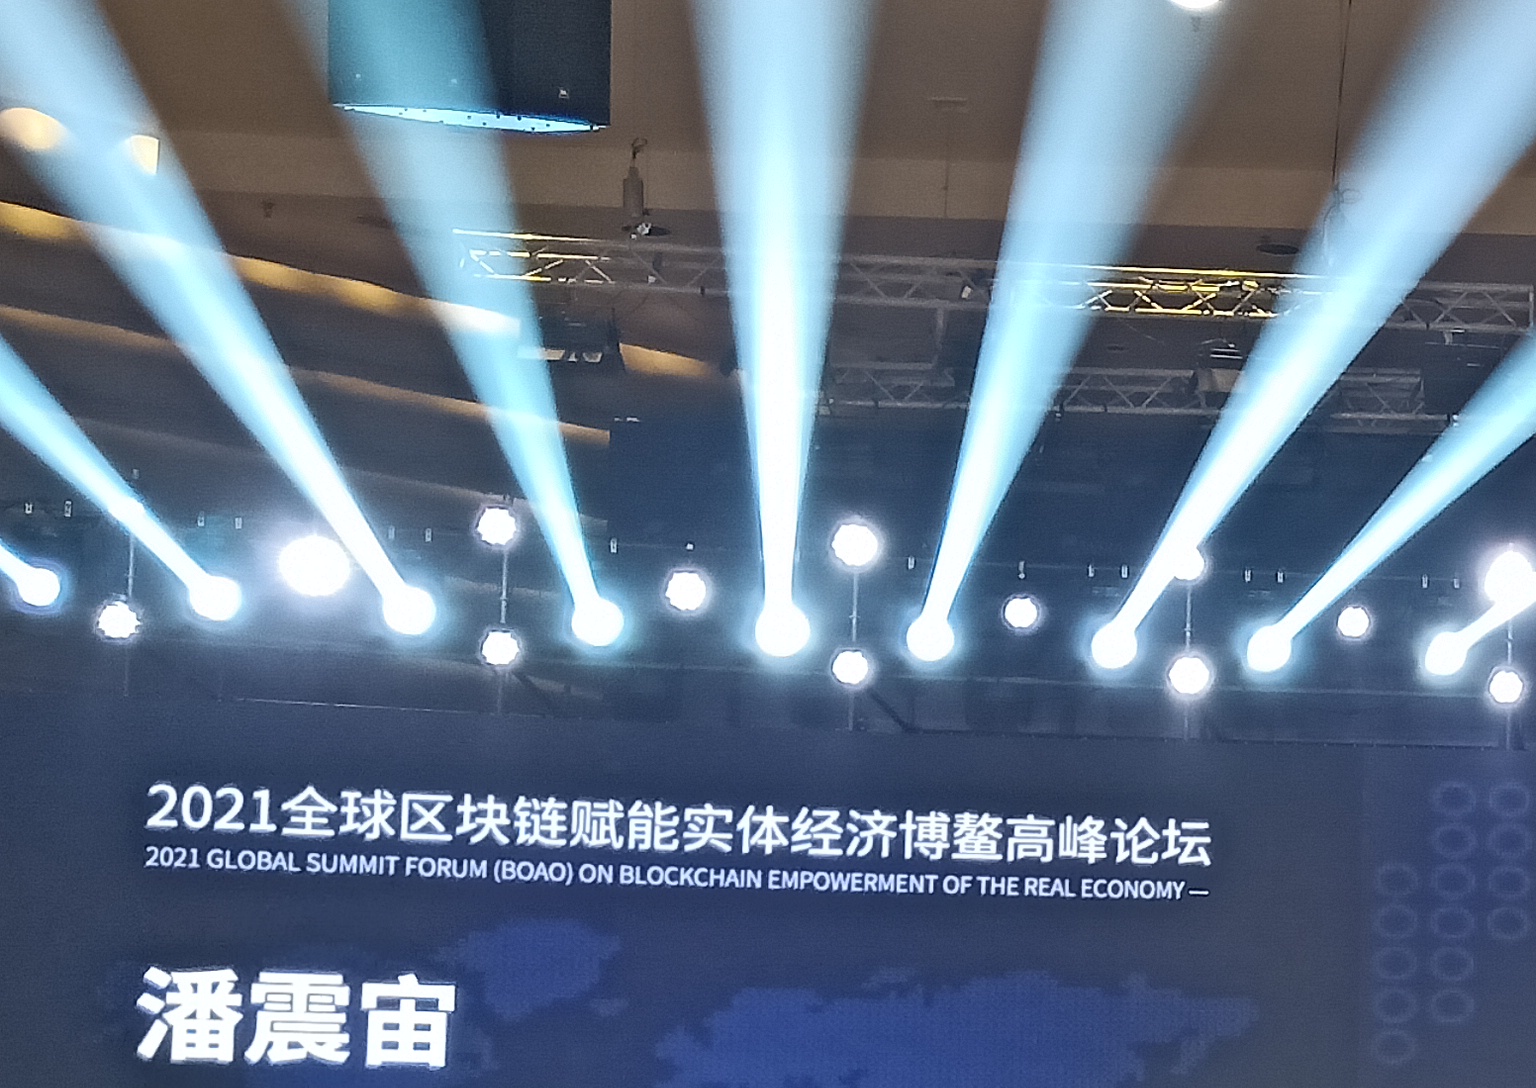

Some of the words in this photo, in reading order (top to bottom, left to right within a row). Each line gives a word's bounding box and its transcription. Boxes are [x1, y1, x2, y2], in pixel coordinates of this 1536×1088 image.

[145, 783, 1212, 866] 2021全球区块链赋能实体经济博鳌高峰论坛
[146, 846, 200, 868] 2021
[207, 848, 301, 872] GLOBAL
[306, 852, 400, 876] SUMMIT
[406, 856, 487, 879] FORUM
[493, 859, 574, 886] (BOAO)
[579, 864, 613, 884] ON
[620, 865, 762, 889] BLOCKCHAIN
[768, 869, 938, 894] EMPOWERMENT
[943, 875, 973, 895] OF
[976, 876, 1019, 896] THE
[1024, 877, 1077, 898] REAL
[1081, 878, 1186, 900] ECONOMY
[136, 966, 457, 1070] 潘震宙
